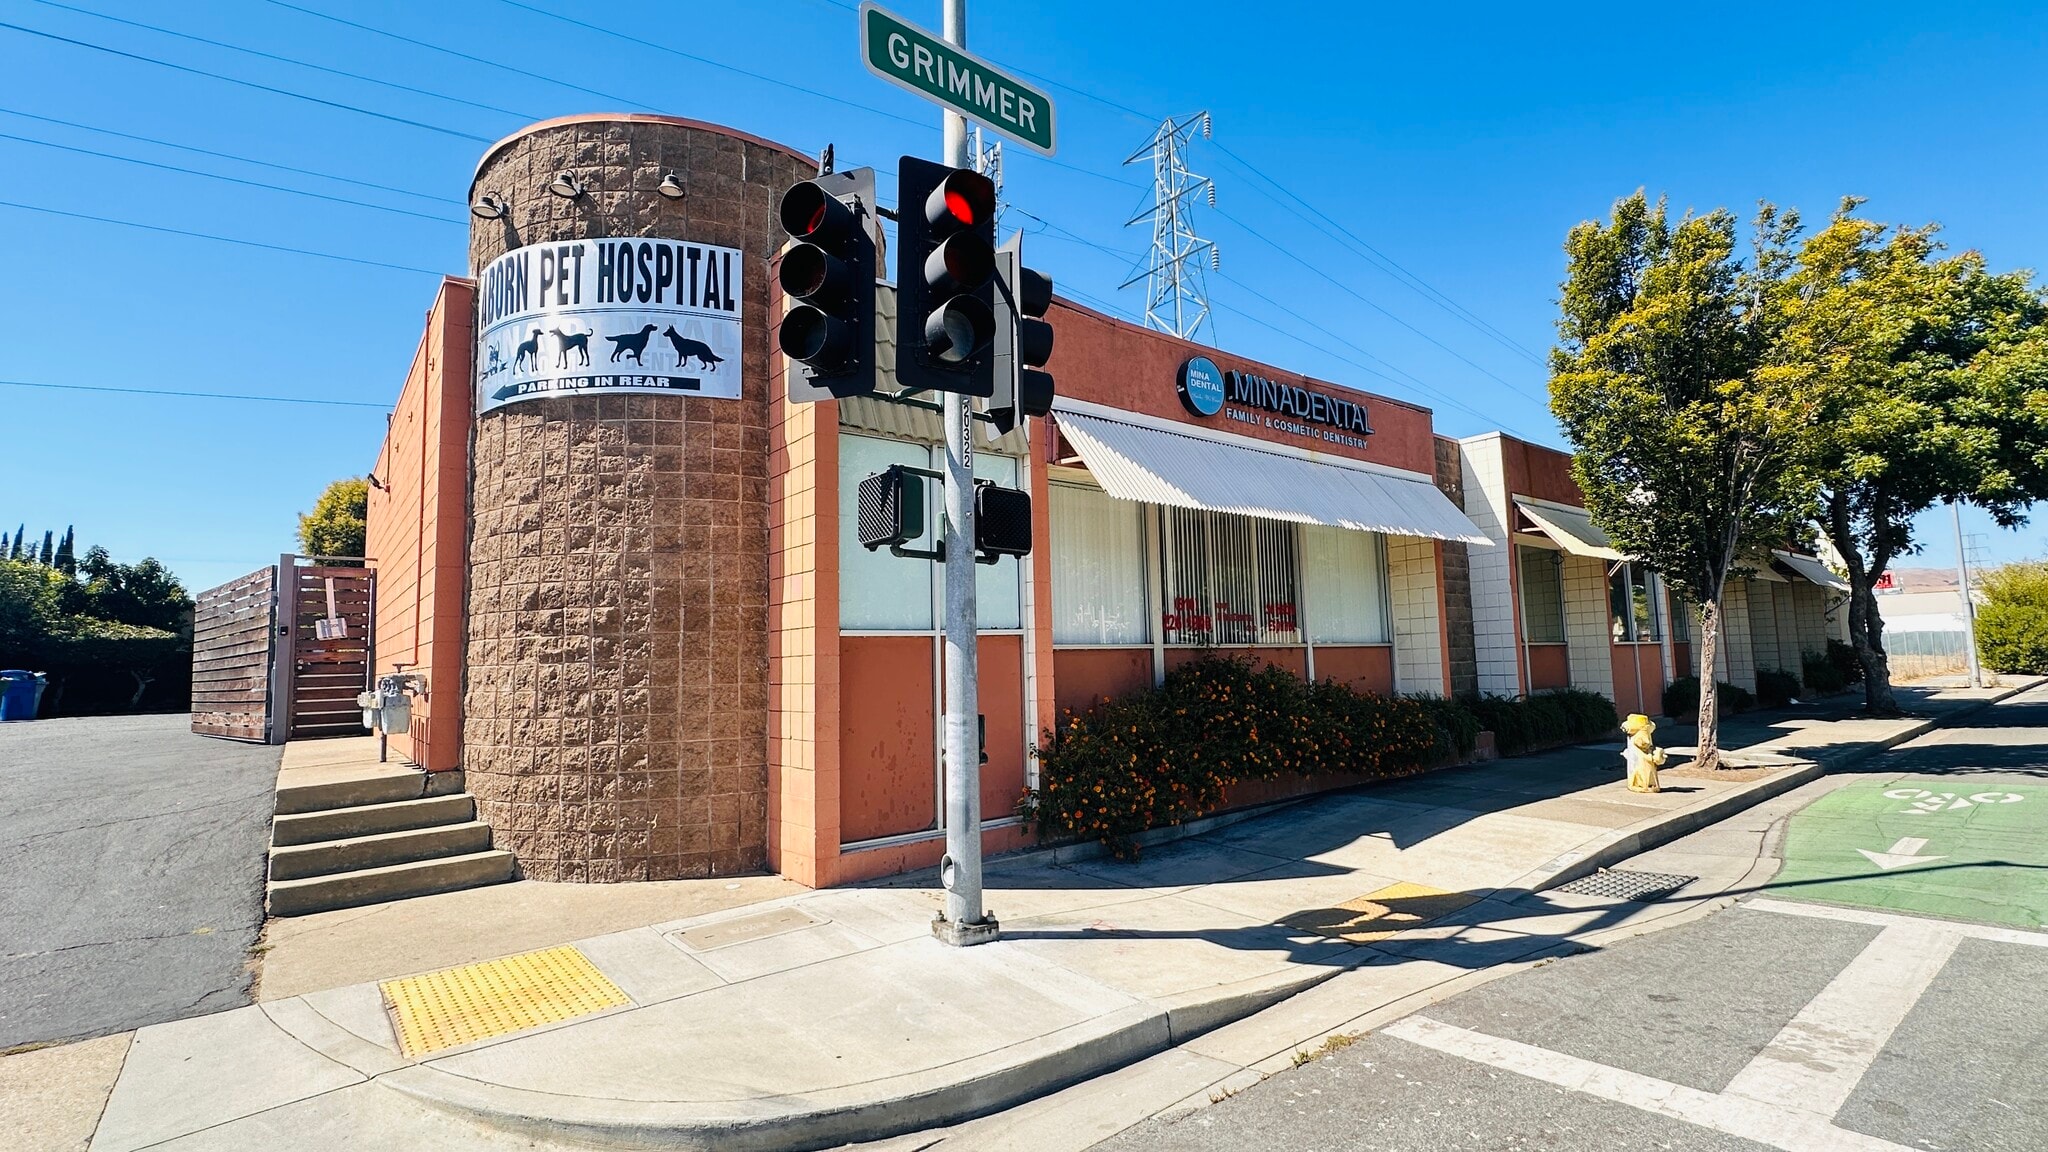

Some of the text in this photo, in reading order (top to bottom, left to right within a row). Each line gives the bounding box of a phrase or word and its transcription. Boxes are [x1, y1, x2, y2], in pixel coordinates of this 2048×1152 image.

[888, 32, 1036, 133] GRIMMER
[481, 241, 735, 331] ABORN PET HOSPITAL
[518, 376, 670, 394] PARKING IN REAR
[1190, 369, 1210, 381] MINA
[1190, 378, 1222, 392] DENTAL
[1230, 369, 1375, 434] MINADENTAL
[1226, 407, 1368, 450] FAMILY & COSMETIC DENTISTRY
